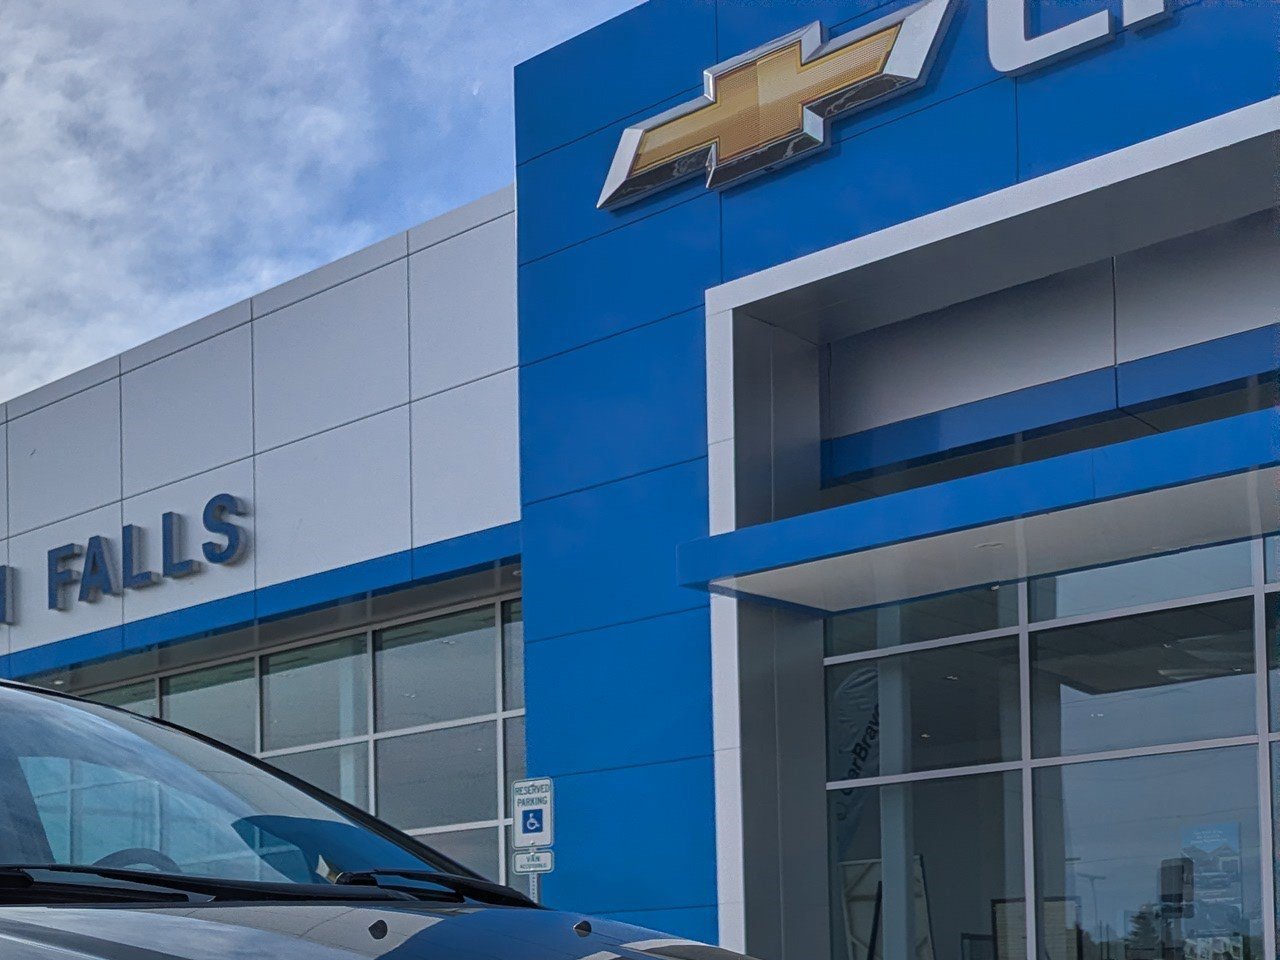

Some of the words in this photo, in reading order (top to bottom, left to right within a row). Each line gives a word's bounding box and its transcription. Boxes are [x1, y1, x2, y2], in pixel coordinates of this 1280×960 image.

[48, 493, 248, 611] FALLS
[840, 703, 880, 796] CarBrav
[515, 784, 550, 796] RESERVED
[517, 796, 548, 807] PARKING
[526, 855, 540, 863] VAN
